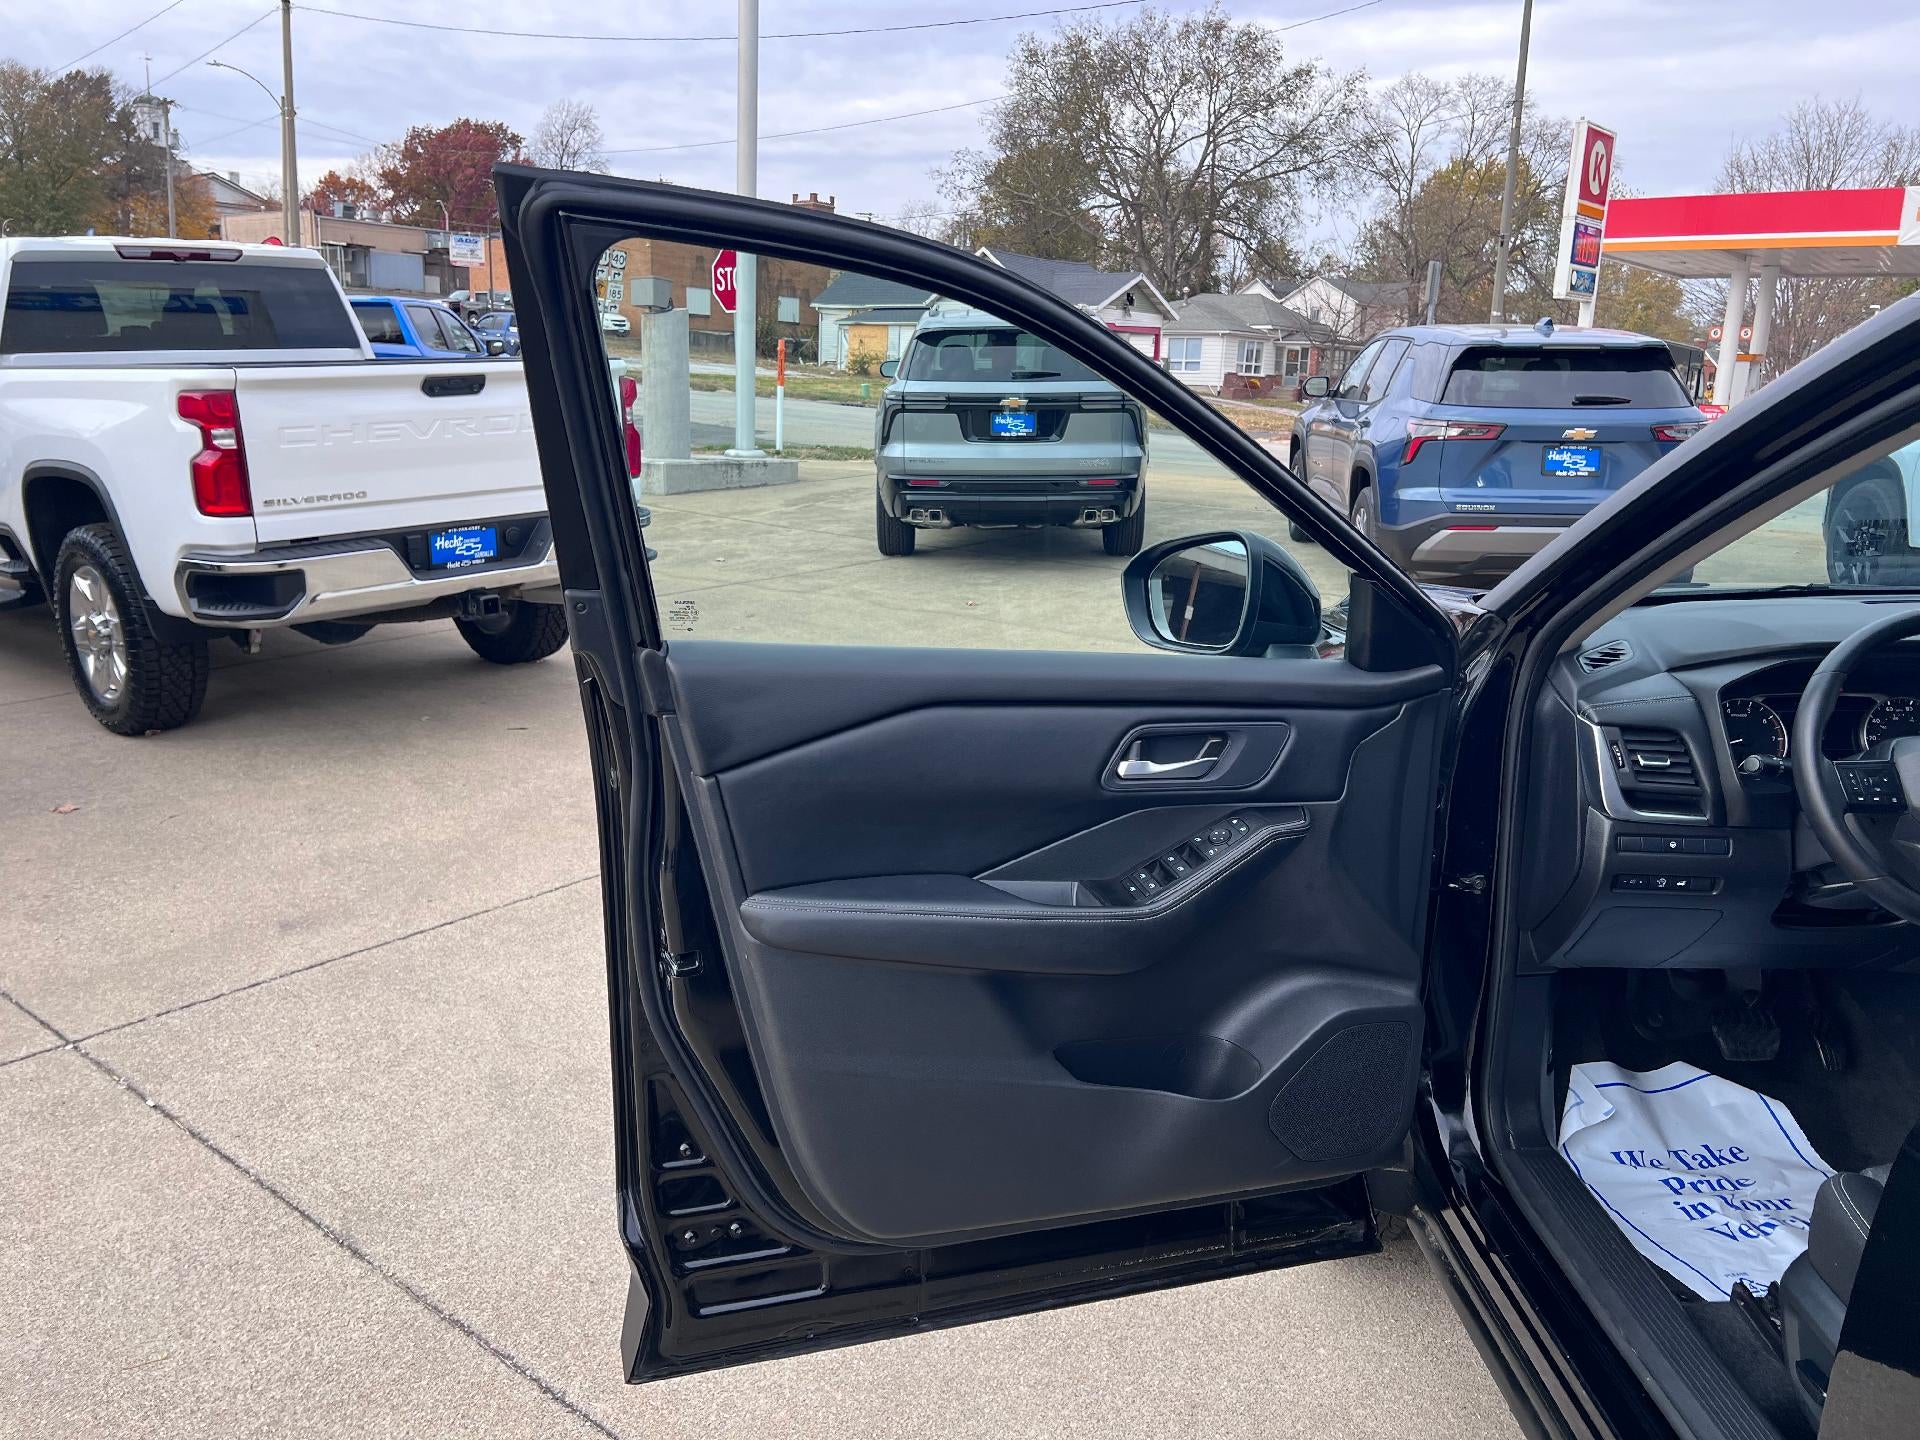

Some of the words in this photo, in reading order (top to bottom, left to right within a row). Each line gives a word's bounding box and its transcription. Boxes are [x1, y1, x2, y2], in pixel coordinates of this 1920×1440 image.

[1591, 151, 1605, 187] K
[612, 254, 625, 265] 40
[609, 288, 622, 300] 185
[262, 490, 368, 508] SILVERADO
[434, 534, 464, 550] Hecht
[1610, 1150, 1670, 1170] We
[1667, 1144, 1750, 1170] Take
[1658, 1174, 1757, 1196] Pride
[1672, 1200, 1717, 1221] in
[1713, 1193, 1798, 1211] Your
